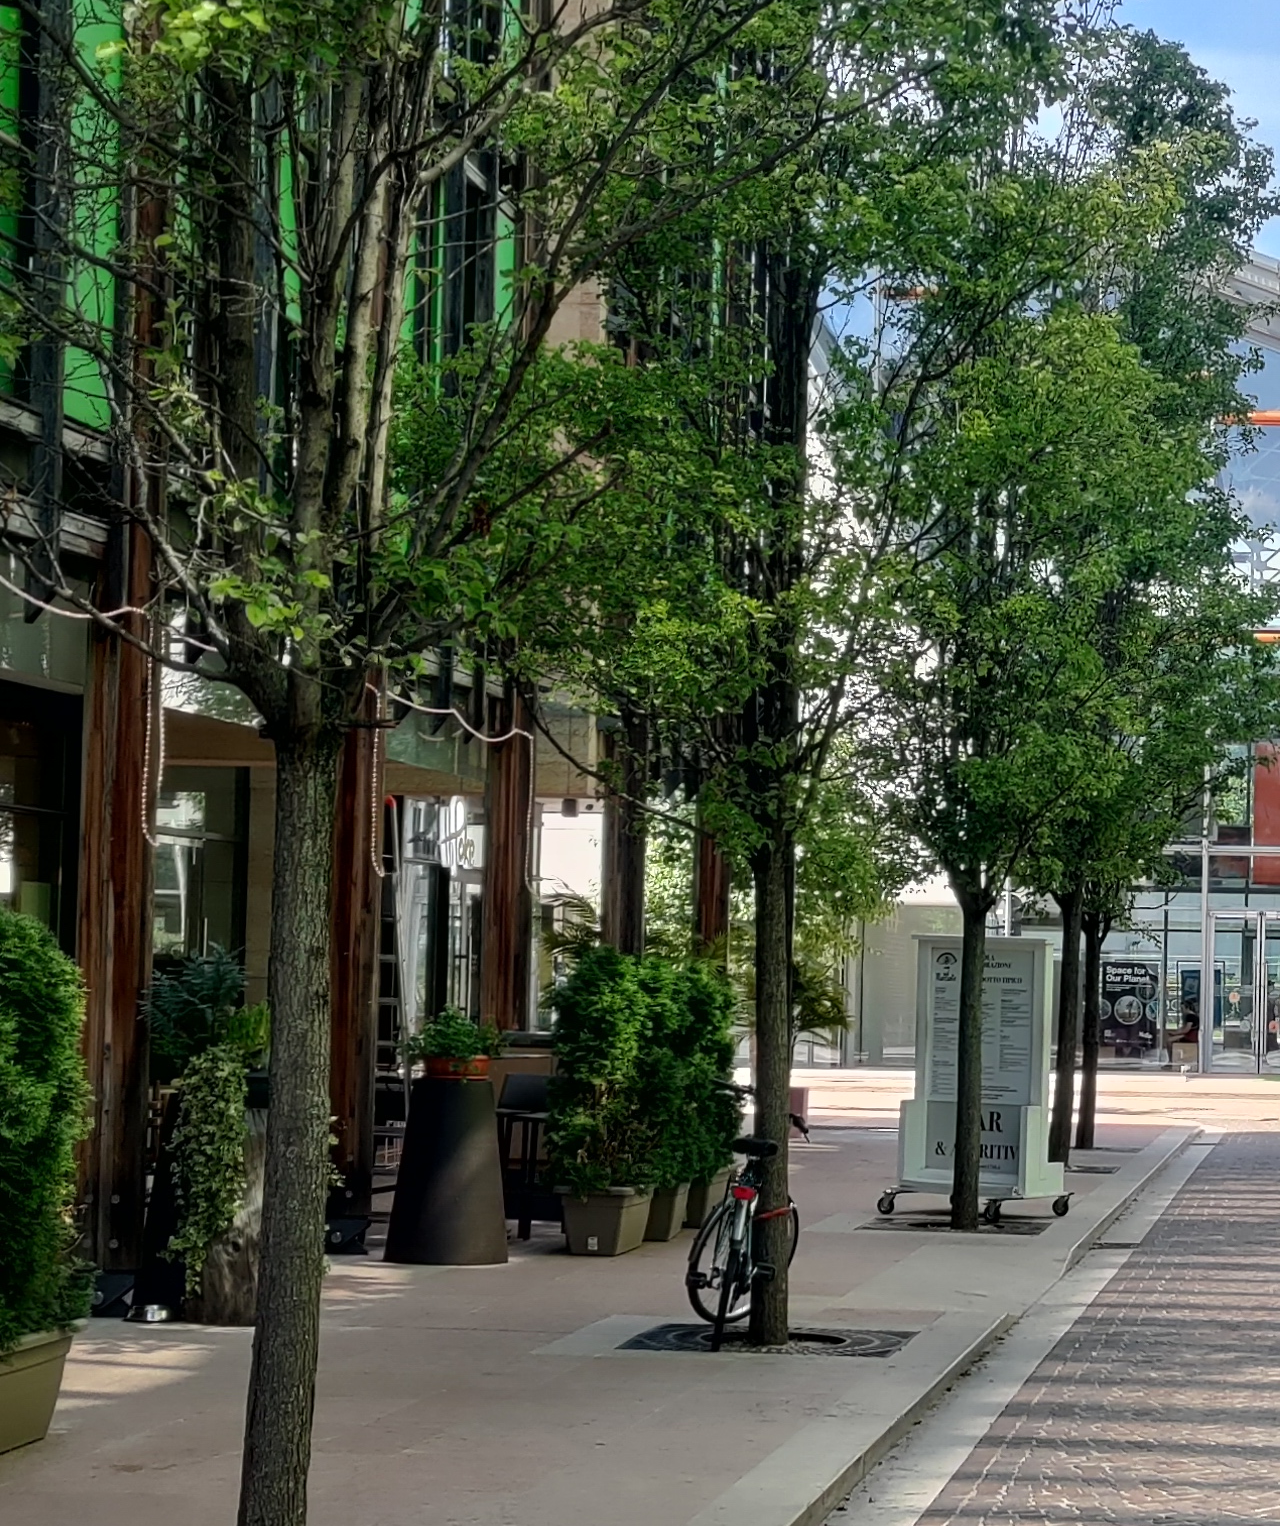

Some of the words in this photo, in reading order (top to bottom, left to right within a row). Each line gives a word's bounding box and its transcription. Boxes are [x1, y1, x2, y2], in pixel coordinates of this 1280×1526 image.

[1106, 966, 1132, 975] Space
[1134, 967, 1146, 975] for
[1106, 974, 1122, 982] Our
[1123, 975, 1150, 983] Planet
[935, 1141, 946, 1156] &
